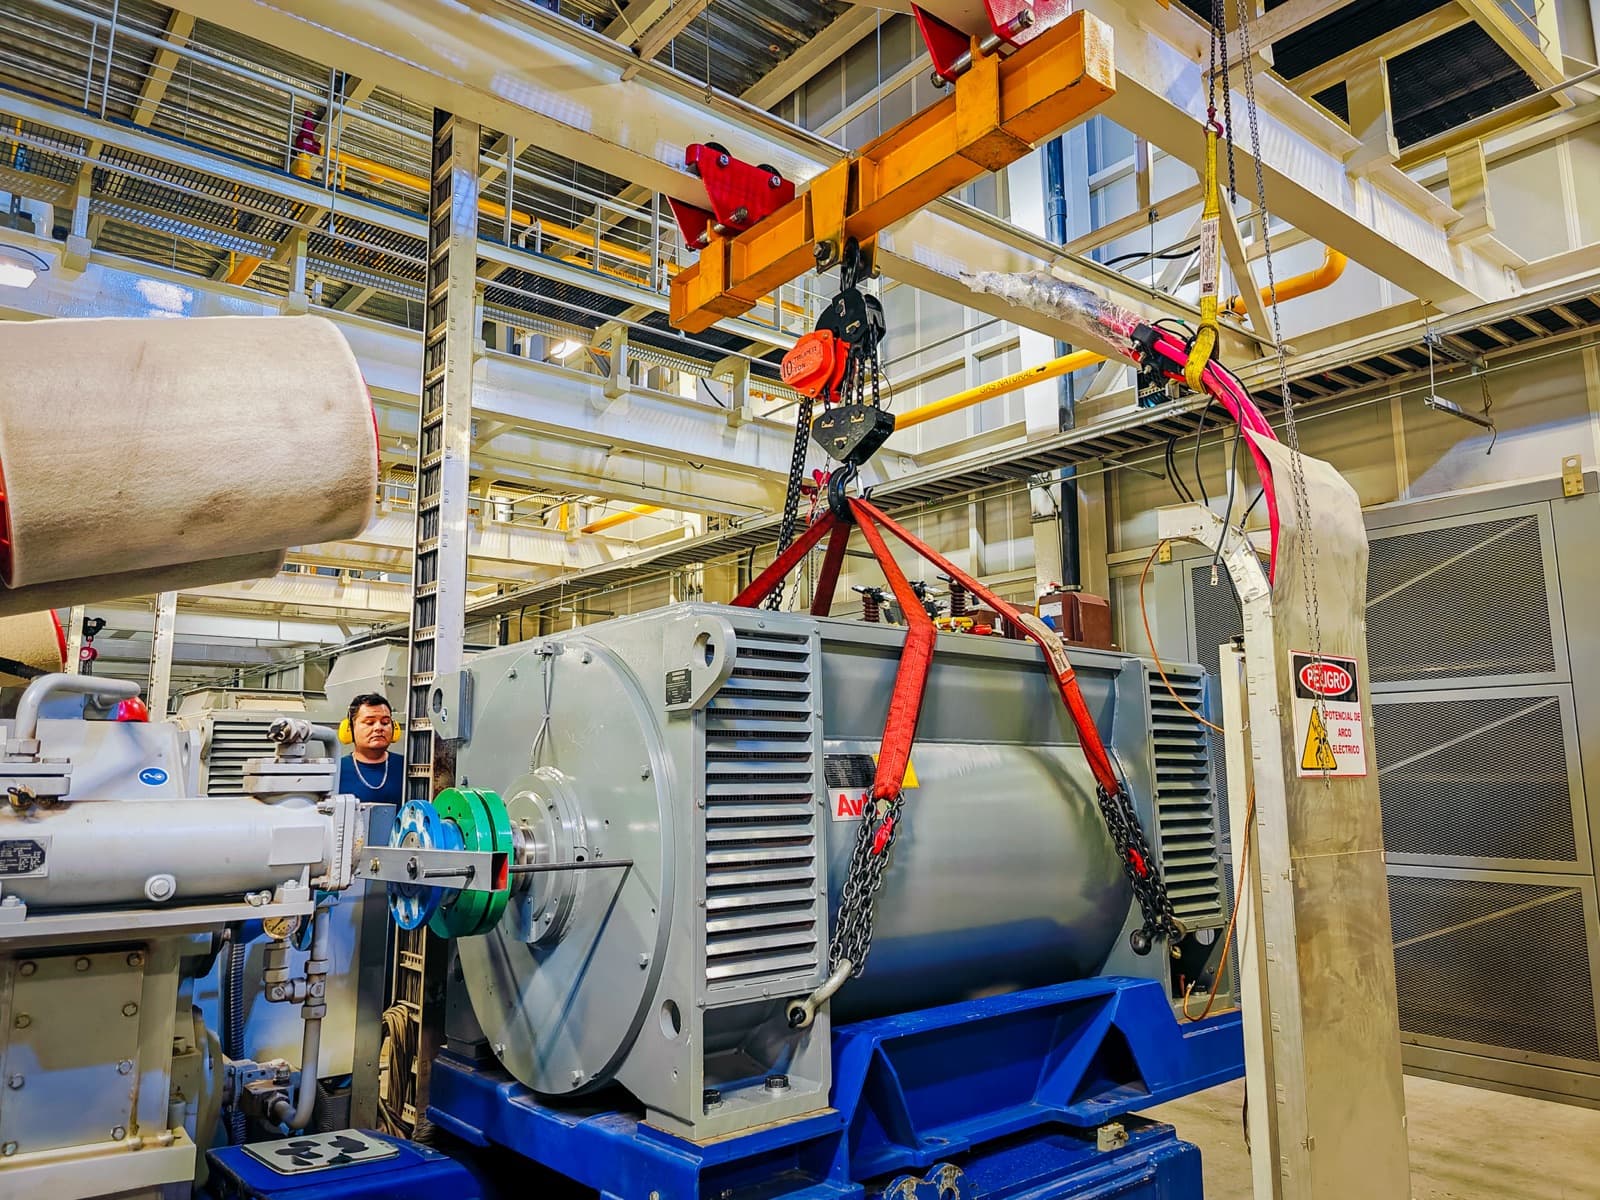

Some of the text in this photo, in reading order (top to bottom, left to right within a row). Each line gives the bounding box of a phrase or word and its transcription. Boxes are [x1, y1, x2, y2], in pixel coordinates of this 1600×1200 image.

[782, 360, 792, 378] 10
[1307, 669, 1346, 690] PELIGRO
[1324, 710, 1361, 722] POTENCIAL DE
[1338, 728, 1351, 737] ARCO
